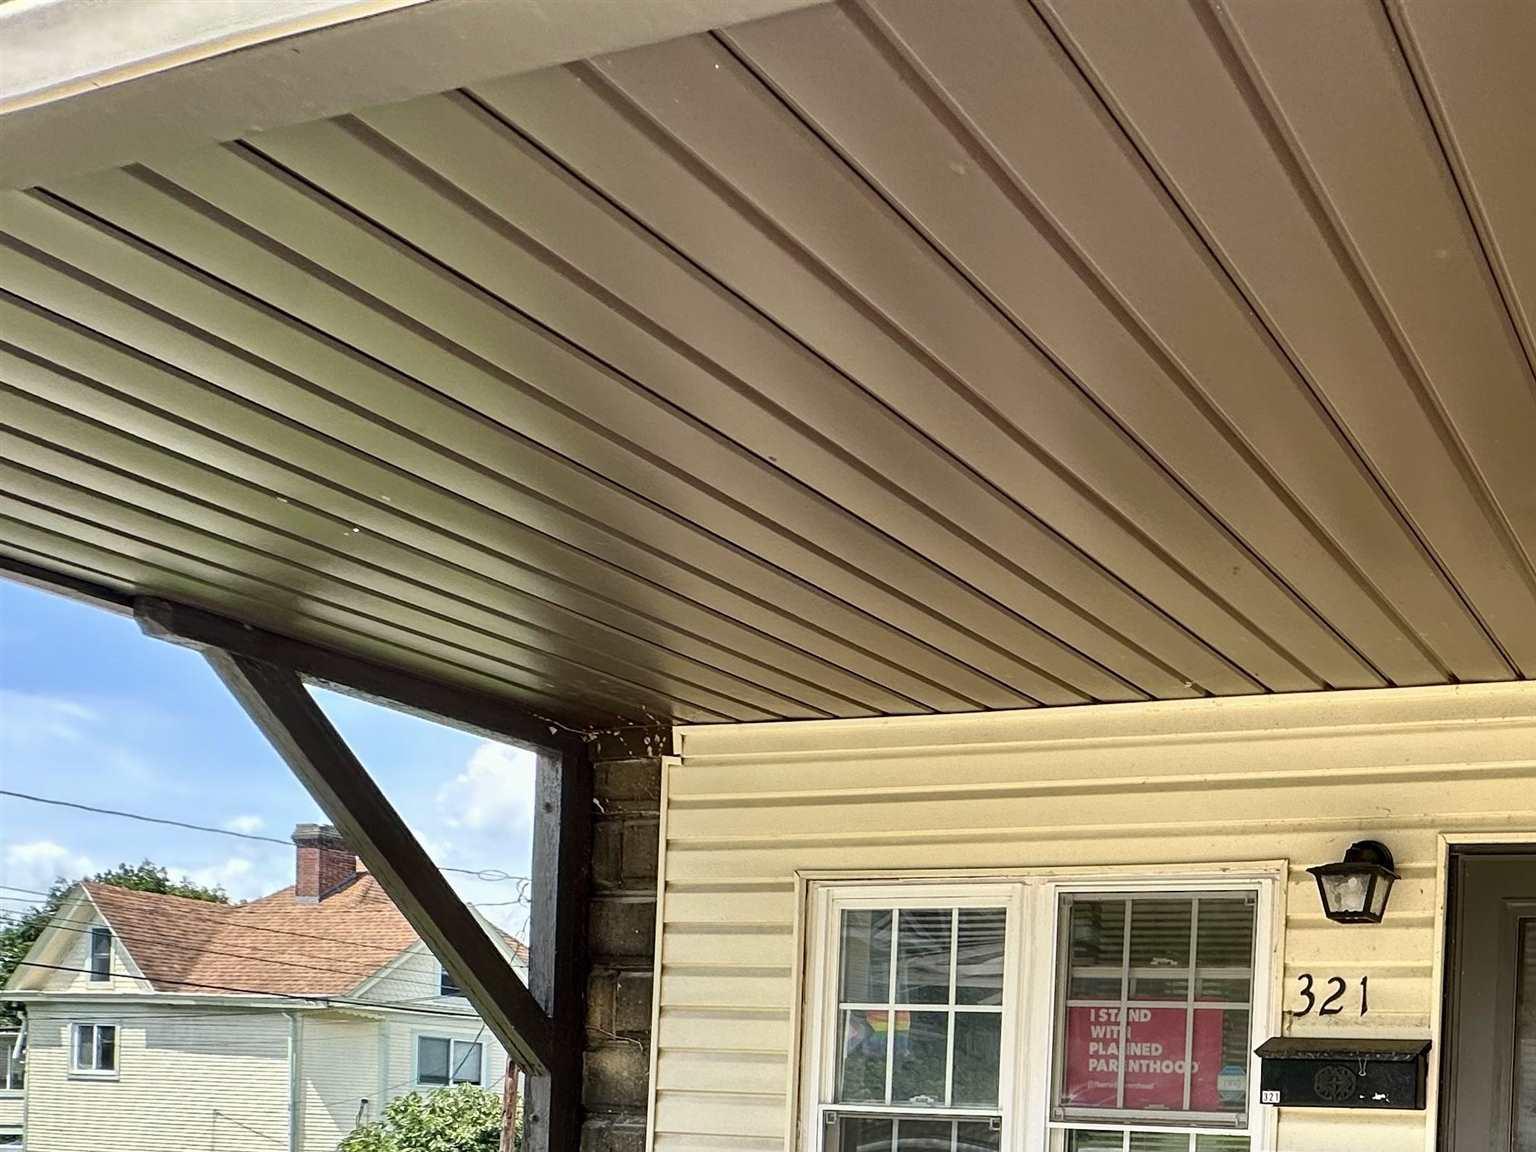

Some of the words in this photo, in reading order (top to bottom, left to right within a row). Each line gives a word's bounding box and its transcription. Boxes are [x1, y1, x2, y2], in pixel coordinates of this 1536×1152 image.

[1293, 973, 1368, 1017] 321
[1090, 1008, 1096, 1022] I
[1098, 1008, 1152, 1023] STND
[1088, 1059, 1200, 1073] PARNTHOOD
[1263, 1091, 1280, 1102] 321
